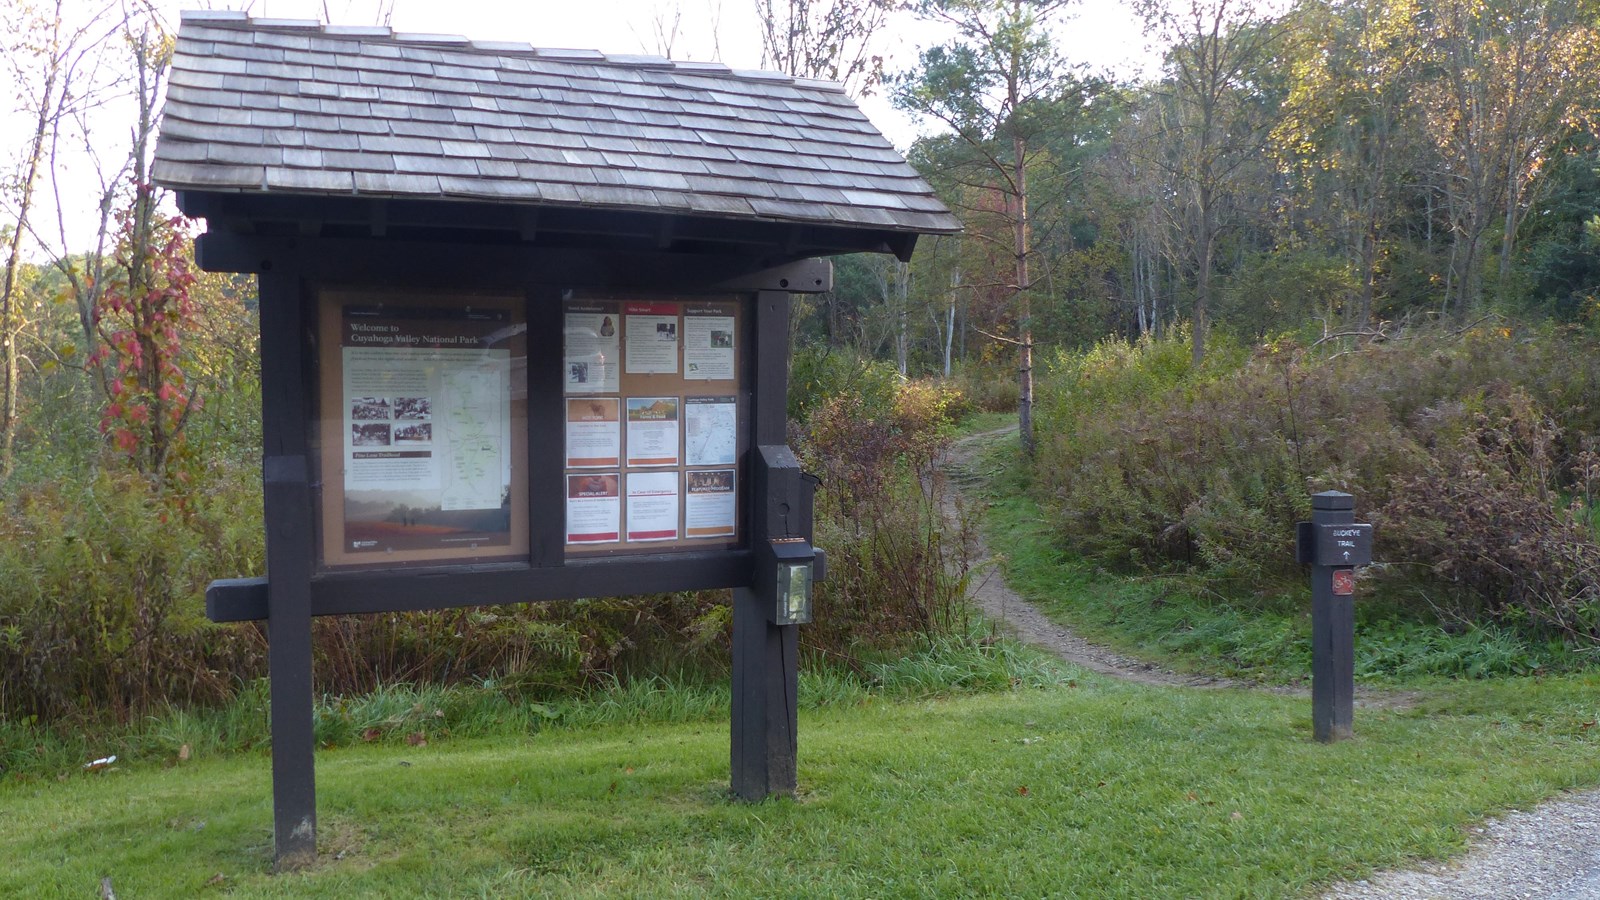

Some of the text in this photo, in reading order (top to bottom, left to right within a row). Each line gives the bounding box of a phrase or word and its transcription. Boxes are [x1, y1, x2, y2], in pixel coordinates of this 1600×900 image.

[351, 323, 400, 332] Welcome to
[351, 333, 479, 345] Cuyahoga Valley National Park
[1333, 529, 1360, 537] BUCKEYE
